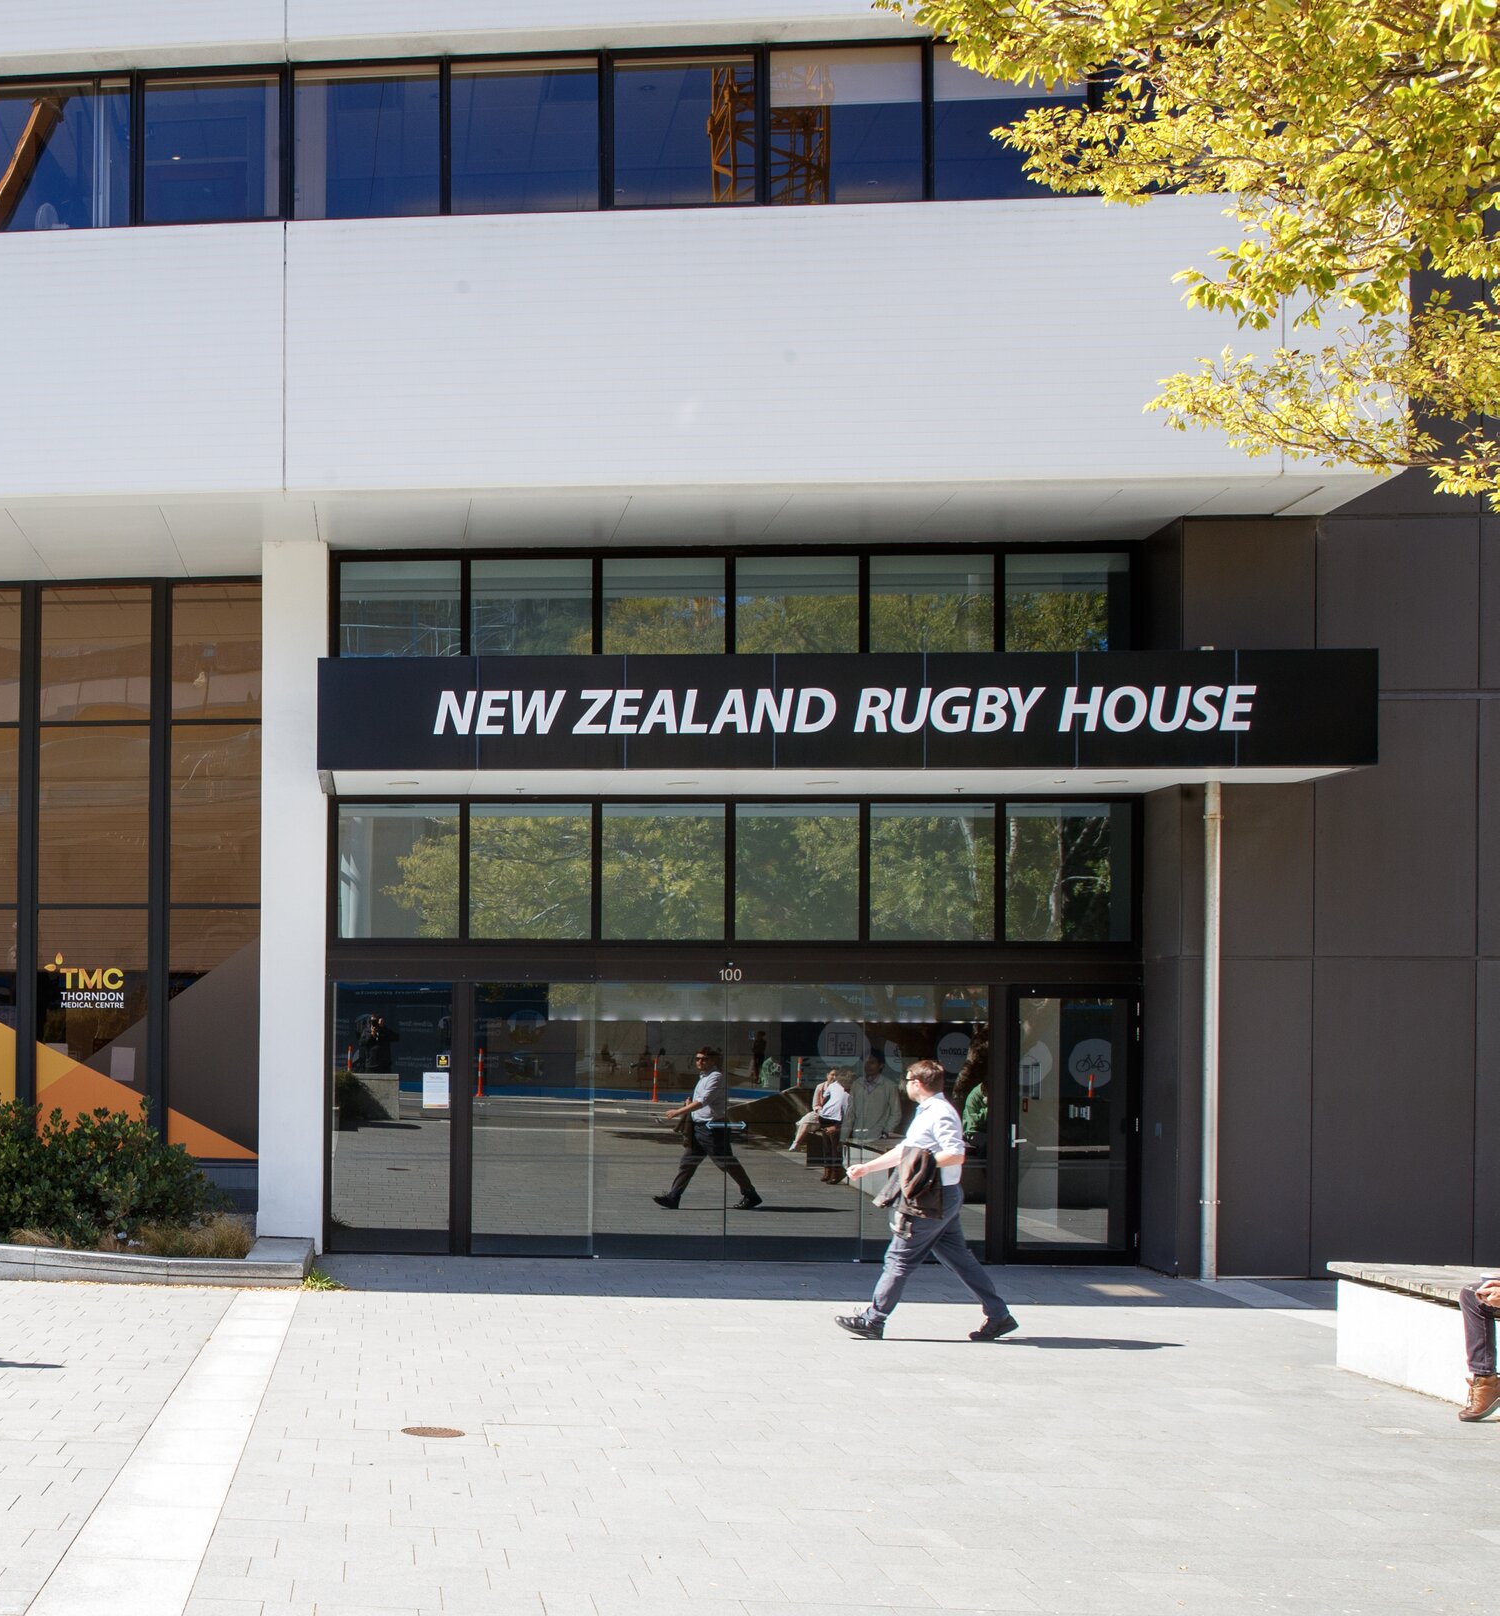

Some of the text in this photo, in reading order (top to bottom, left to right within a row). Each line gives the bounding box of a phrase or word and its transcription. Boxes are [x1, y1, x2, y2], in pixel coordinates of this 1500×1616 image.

[433, 685, 1257, 735] NEW ZEALAND RUGBY HOUSE
[60, 968, 124, 990] TMC
[719, 968, 742, 981] 100
[60, 991, 124, 1001] THORNDON
[60, 1001, 125, 1009] MEDICAL CENTRE
